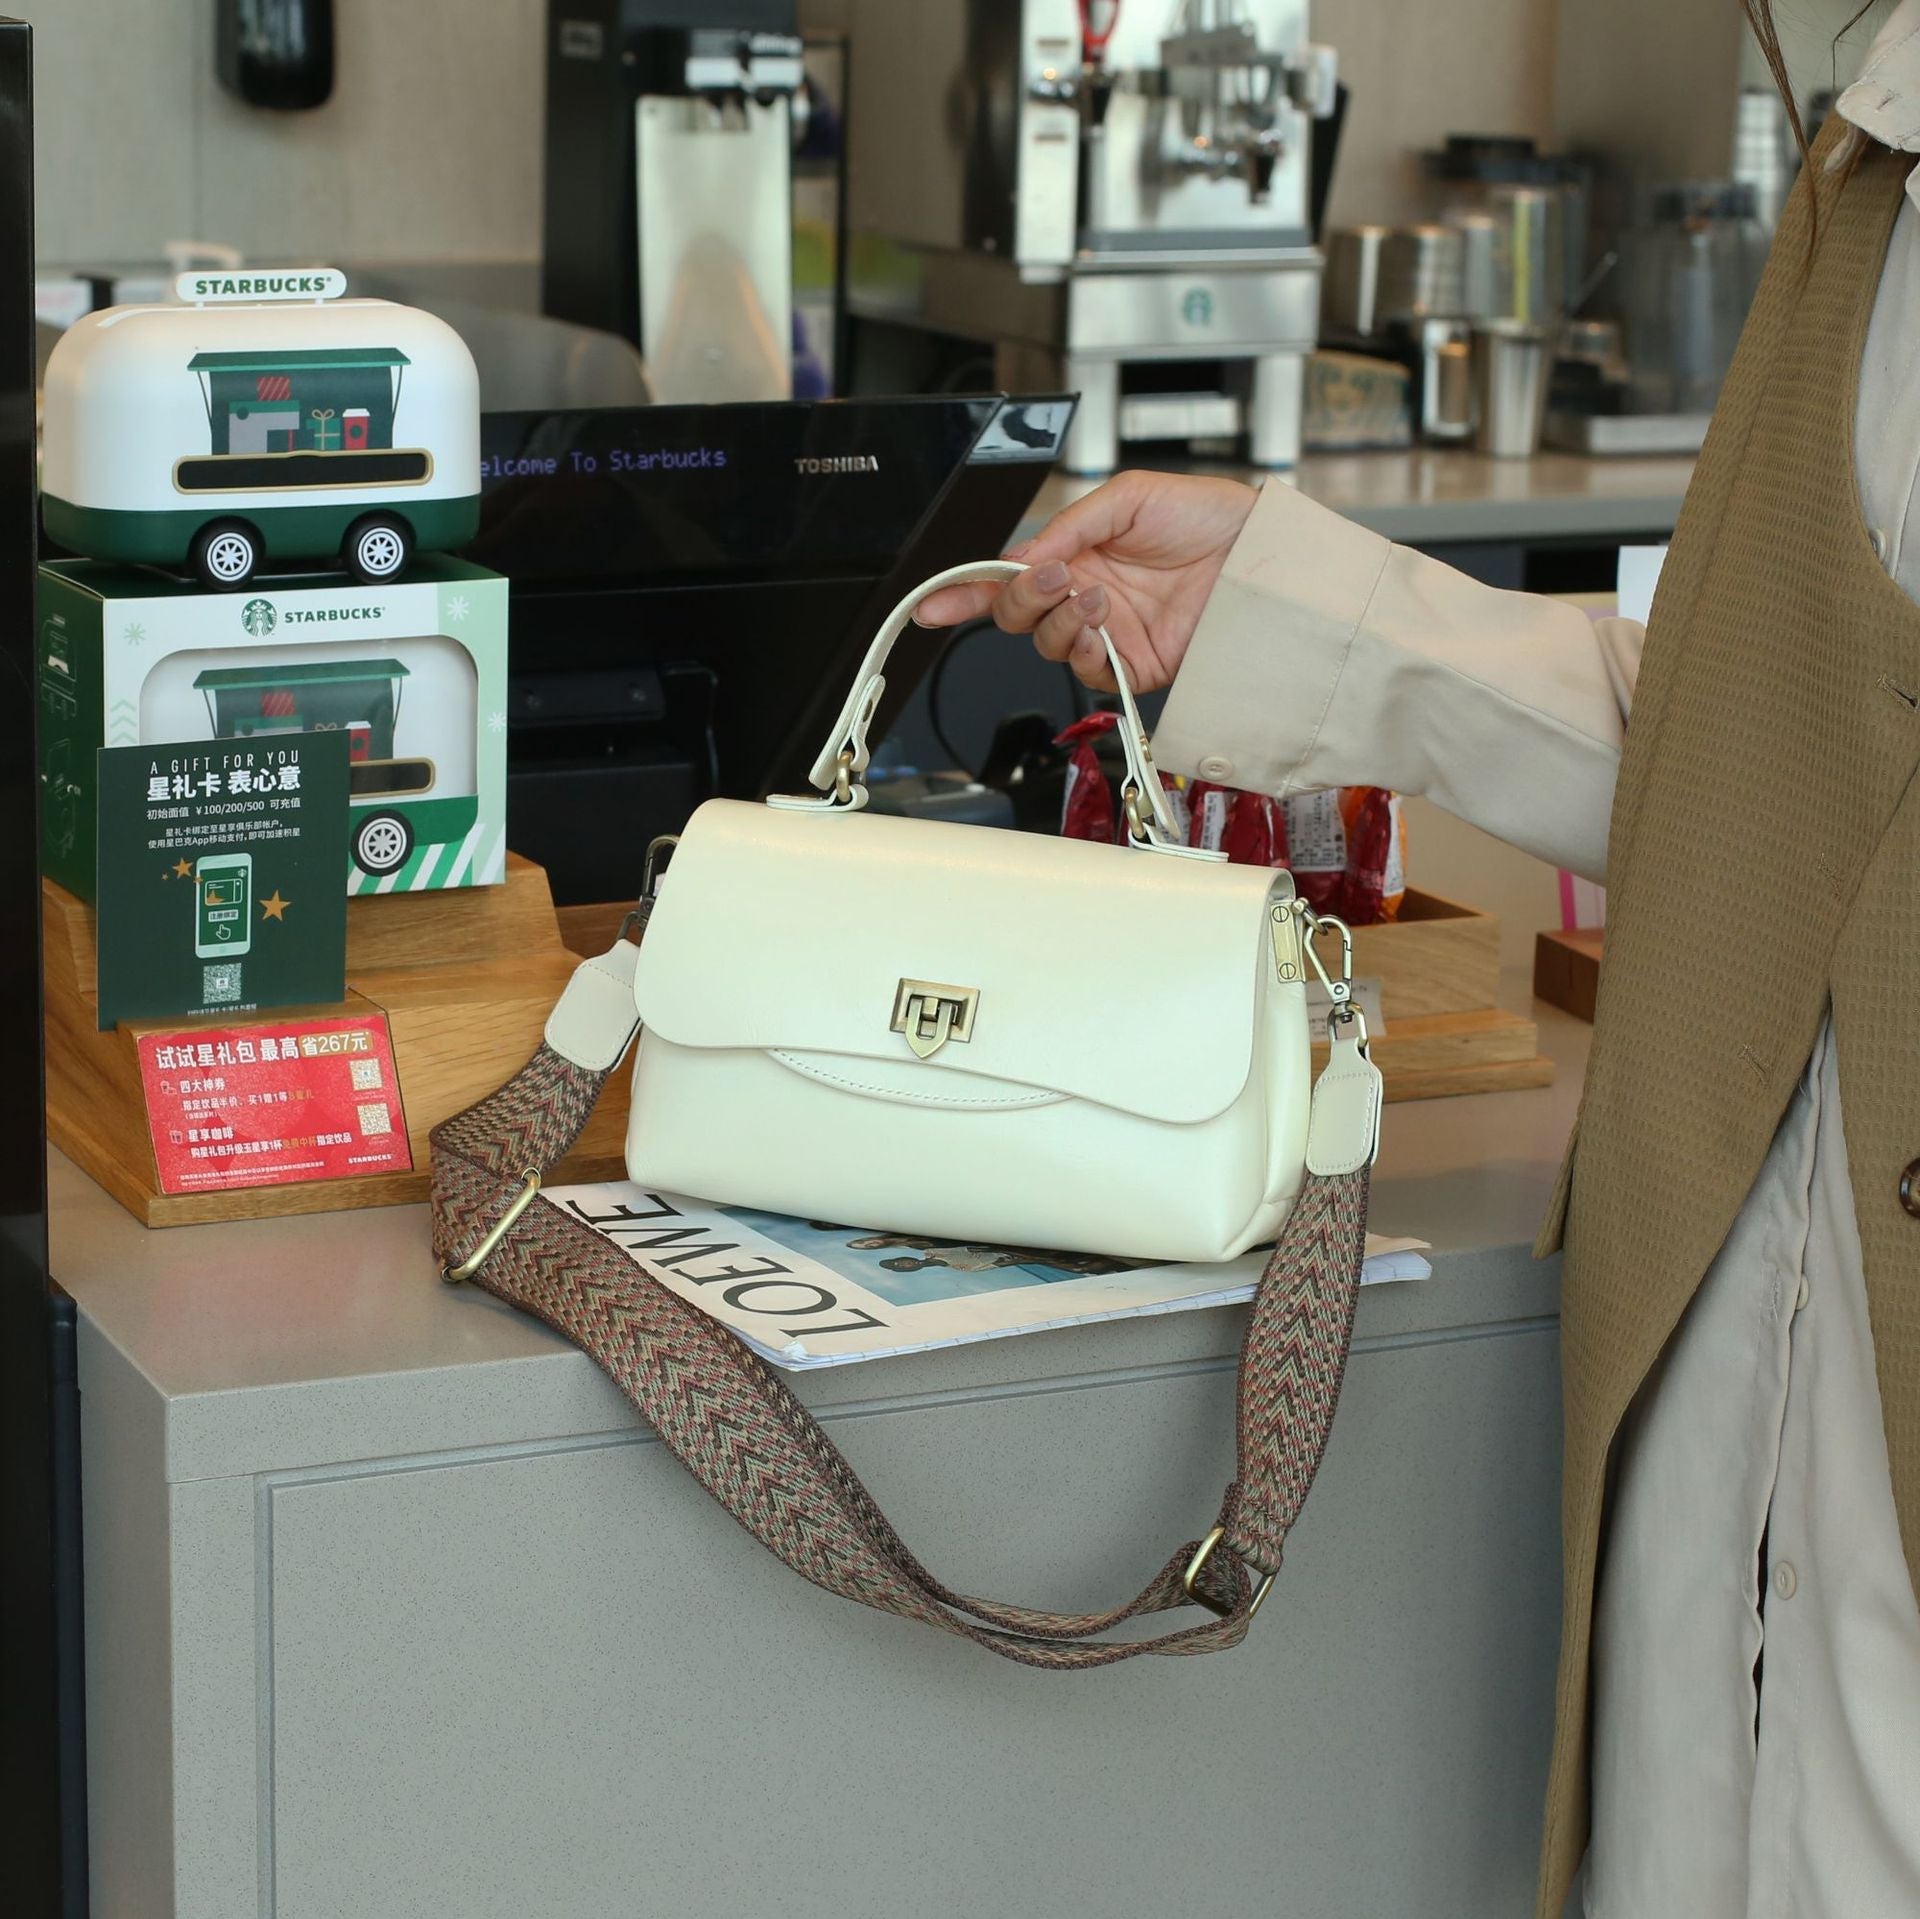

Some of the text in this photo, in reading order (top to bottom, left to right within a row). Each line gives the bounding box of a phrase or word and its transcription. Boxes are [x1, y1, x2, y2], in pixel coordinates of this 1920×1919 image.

[195, 276, 326, 295] STARBUCKS
[481, 447, 727, 477] elcome To Starbucks
[794, 455, 879, 474] TOSHIBA
[284, 607, 382, 624] STARBUCKS
[150, 750, 299, 775] A GIFT FOR YOU
[147, 765, 301, 802] 星礼卡 表心意
[146, 806, 190, 820] 初始面值
[270, 797, 301, 810] 可充值
[156, 1040, 256, 1070] 试试星礼包
[188, 1126, 234, 1143] 星享咖啡
[348, 1153, 392, 1165] STARBUCKS
[564, 1193, 891, 1338] LOEWE
